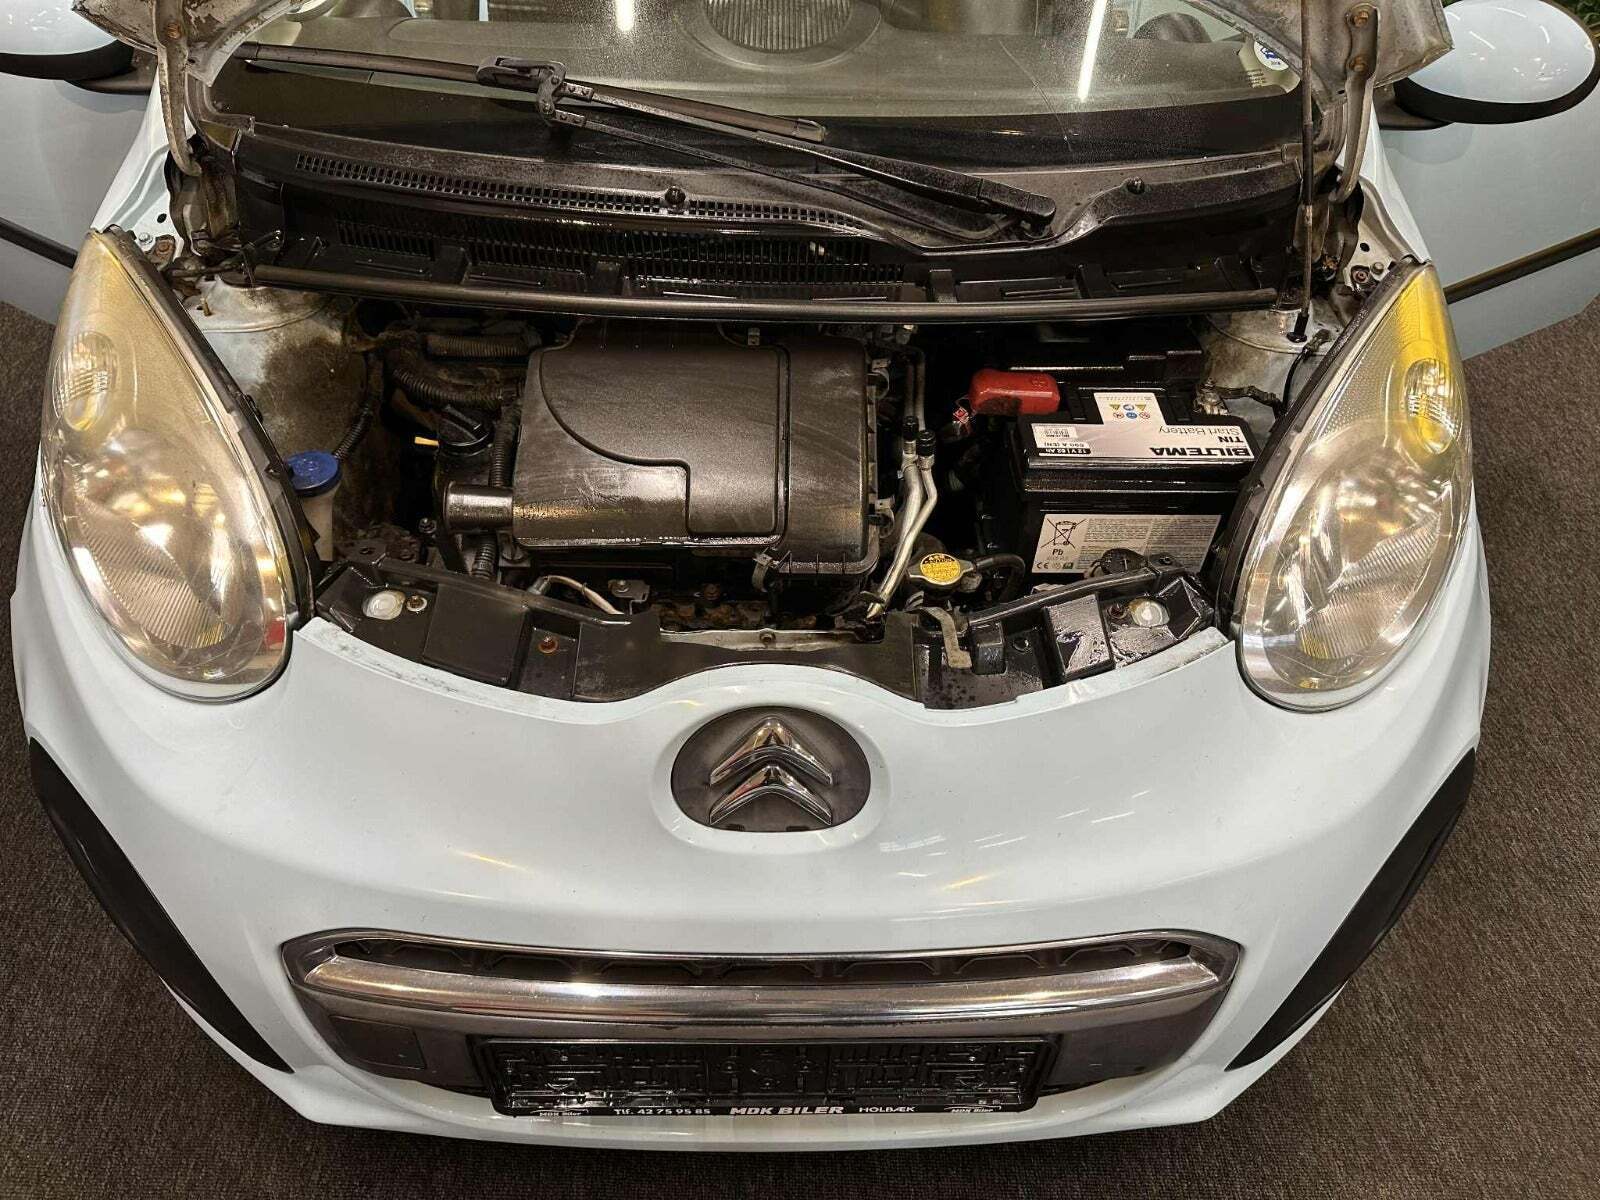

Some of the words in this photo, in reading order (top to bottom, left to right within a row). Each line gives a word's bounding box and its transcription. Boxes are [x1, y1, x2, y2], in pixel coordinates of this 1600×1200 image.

[1159, 425, 1206, 435] Battery
[1208, 427, 1240, 435] Start
[1149, 447, 1251, 456] BILTEMA
[729, 1106, 774, 1115] MDK
[777, 1106, 844, 1115] BILER
